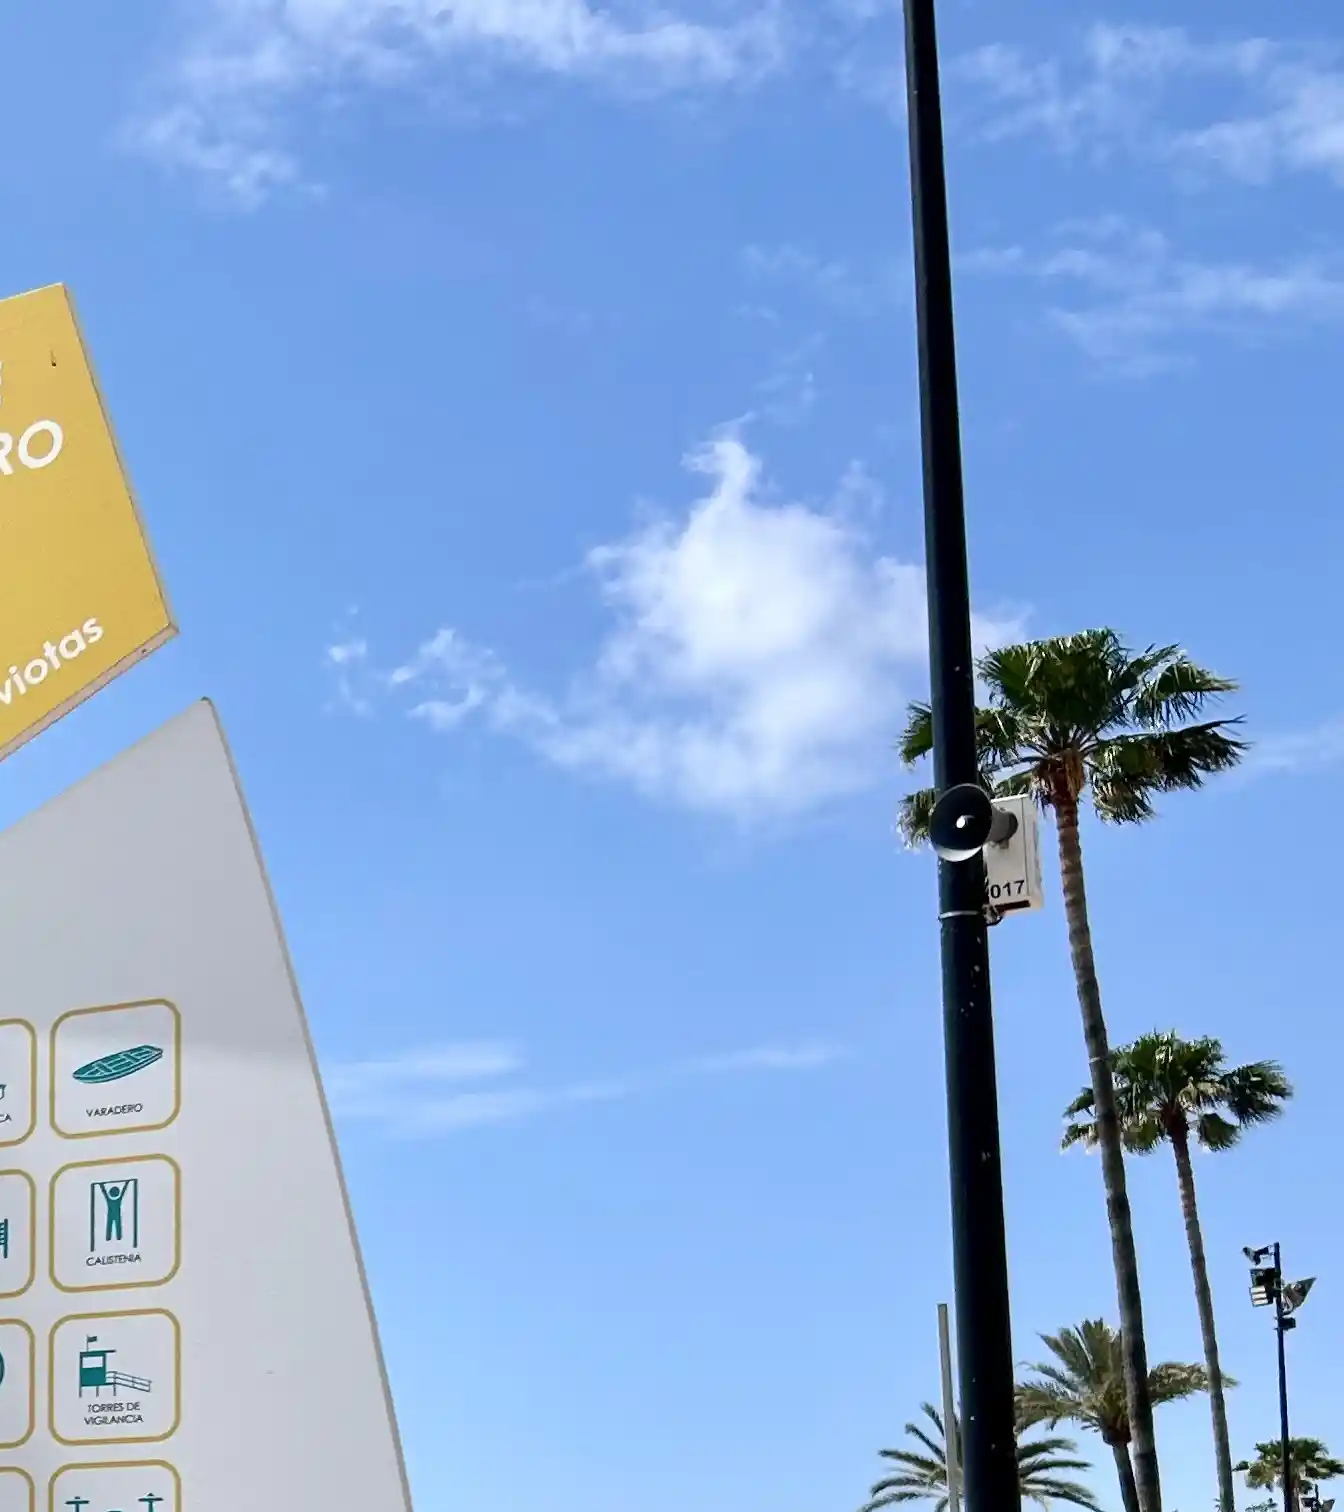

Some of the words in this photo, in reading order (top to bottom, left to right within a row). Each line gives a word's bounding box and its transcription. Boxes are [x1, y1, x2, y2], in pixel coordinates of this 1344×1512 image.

[990, 879, 1025, 899] 017
[85, 1103, 144, 1118] VARADERO
[85, 1253, 143, 1267] CALISTENIA
[87, 1402, 125, 1414] TORRES
[126, 1401, 142, 1412] DE
[83, 1414, 145, 1426] VIGILANCIA
